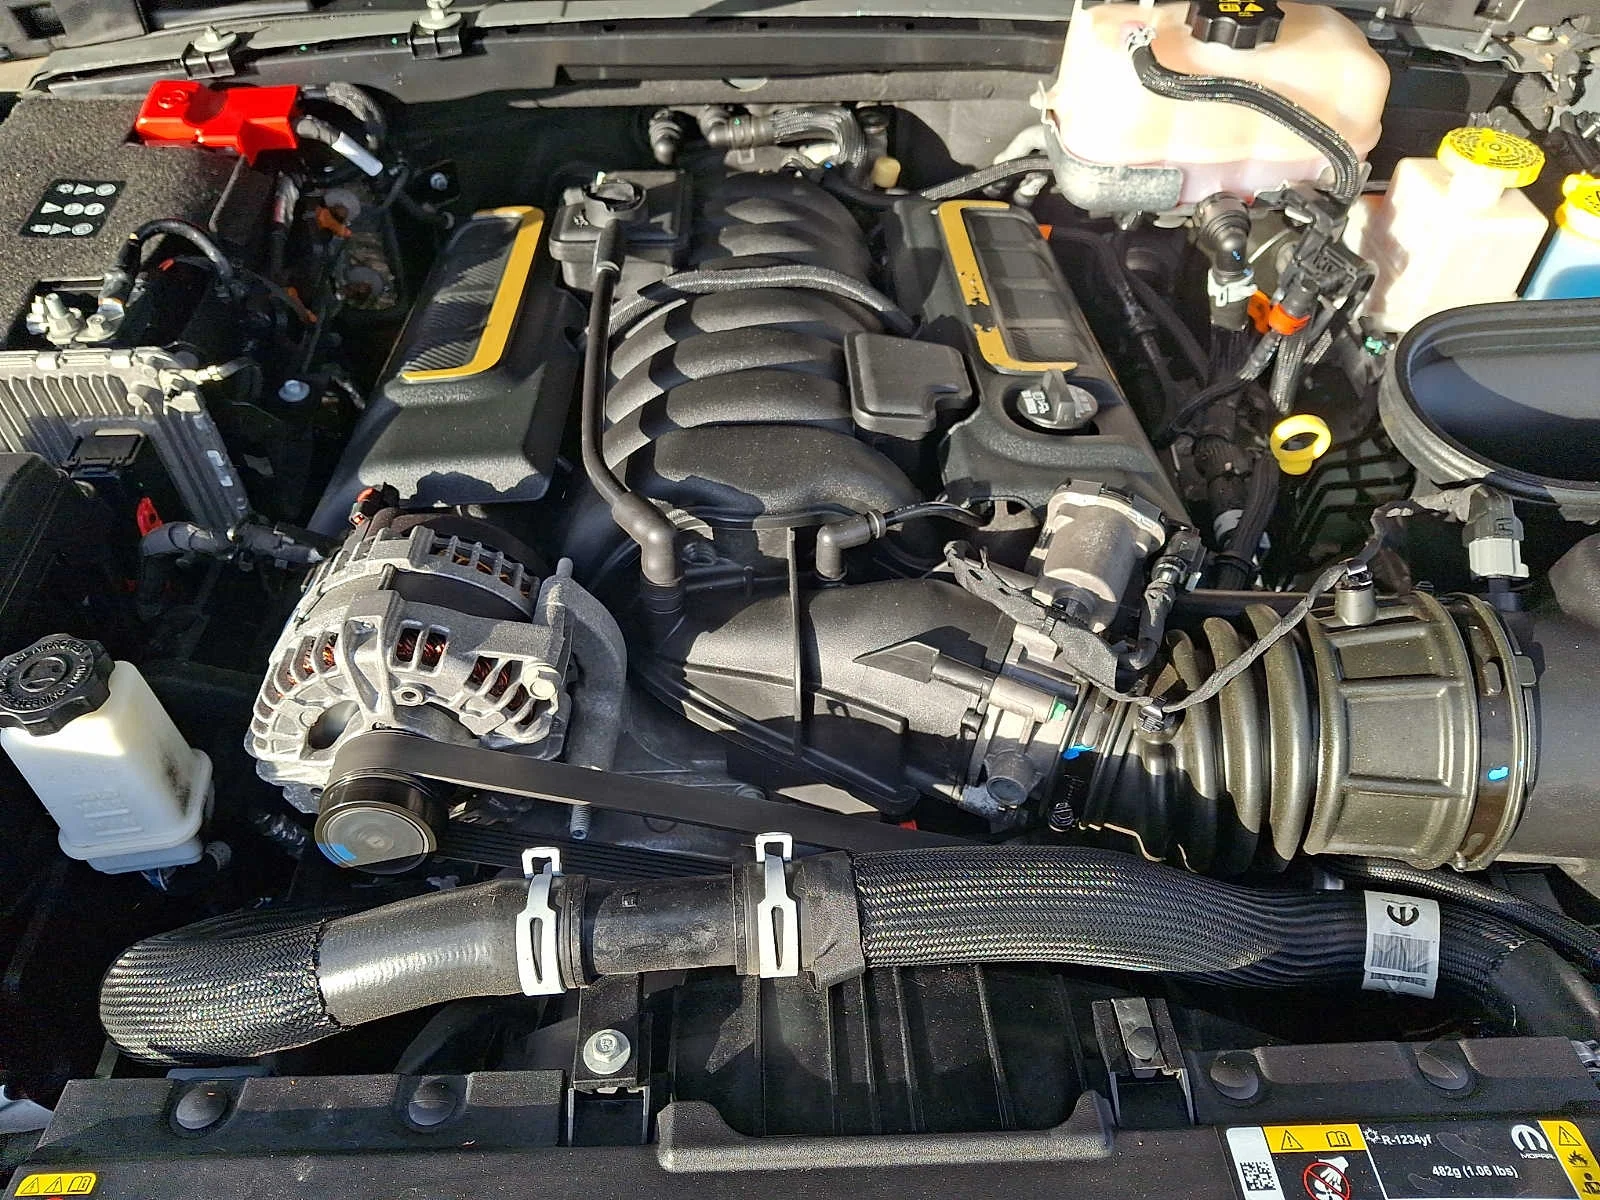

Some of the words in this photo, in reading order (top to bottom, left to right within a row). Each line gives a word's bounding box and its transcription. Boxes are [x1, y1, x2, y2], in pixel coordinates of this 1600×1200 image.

[1381, 1134, 1433, 1148] R-1234yf
[1432, 1165, 1462, 1179] 482g
[1492, 1165, 1519, 1179] lbs)
